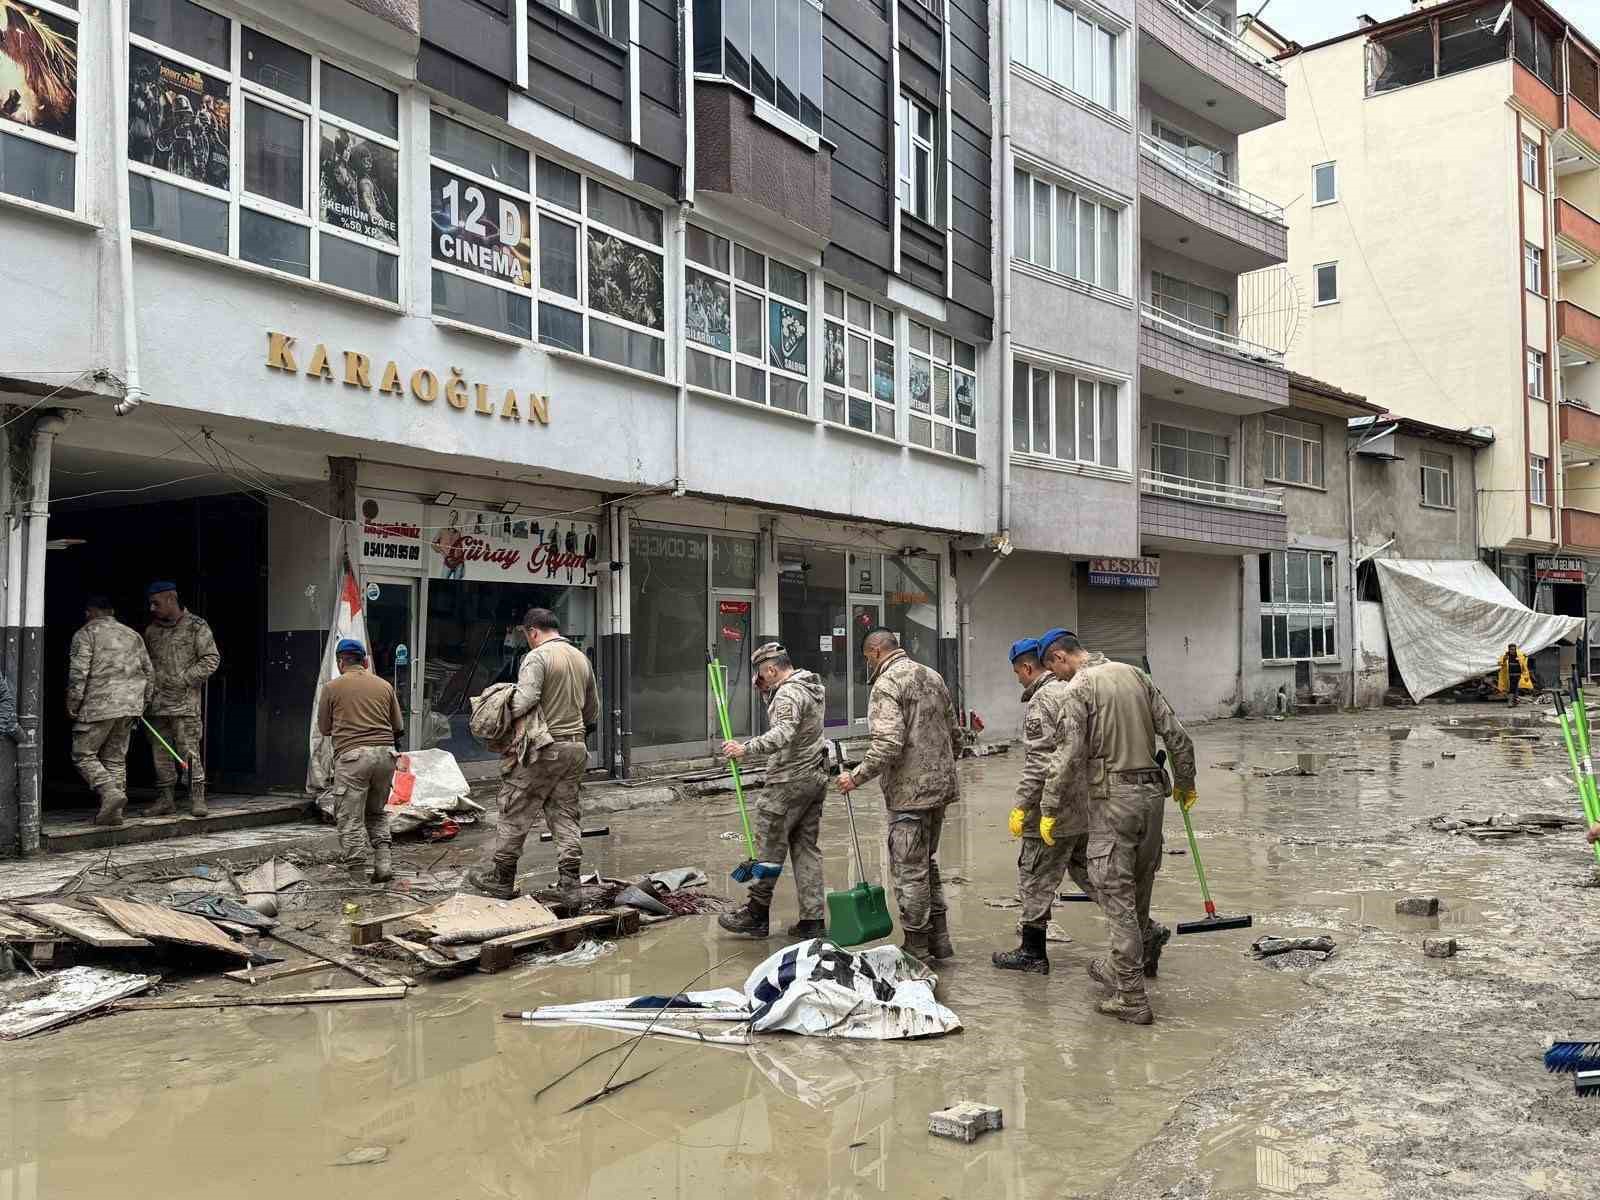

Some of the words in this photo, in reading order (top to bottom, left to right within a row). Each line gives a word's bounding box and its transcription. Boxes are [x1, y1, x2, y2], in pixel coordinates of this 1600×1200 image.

[340, 217, 361, 232] %50
[371, 215, 397, 232] CAFE
[442, 179, 486, 236] 12
[498, 198, 521, 247] D
[440, 233, 523, 278] CINEMA
[265, 331, 550, 425] KARAOĞLAN
